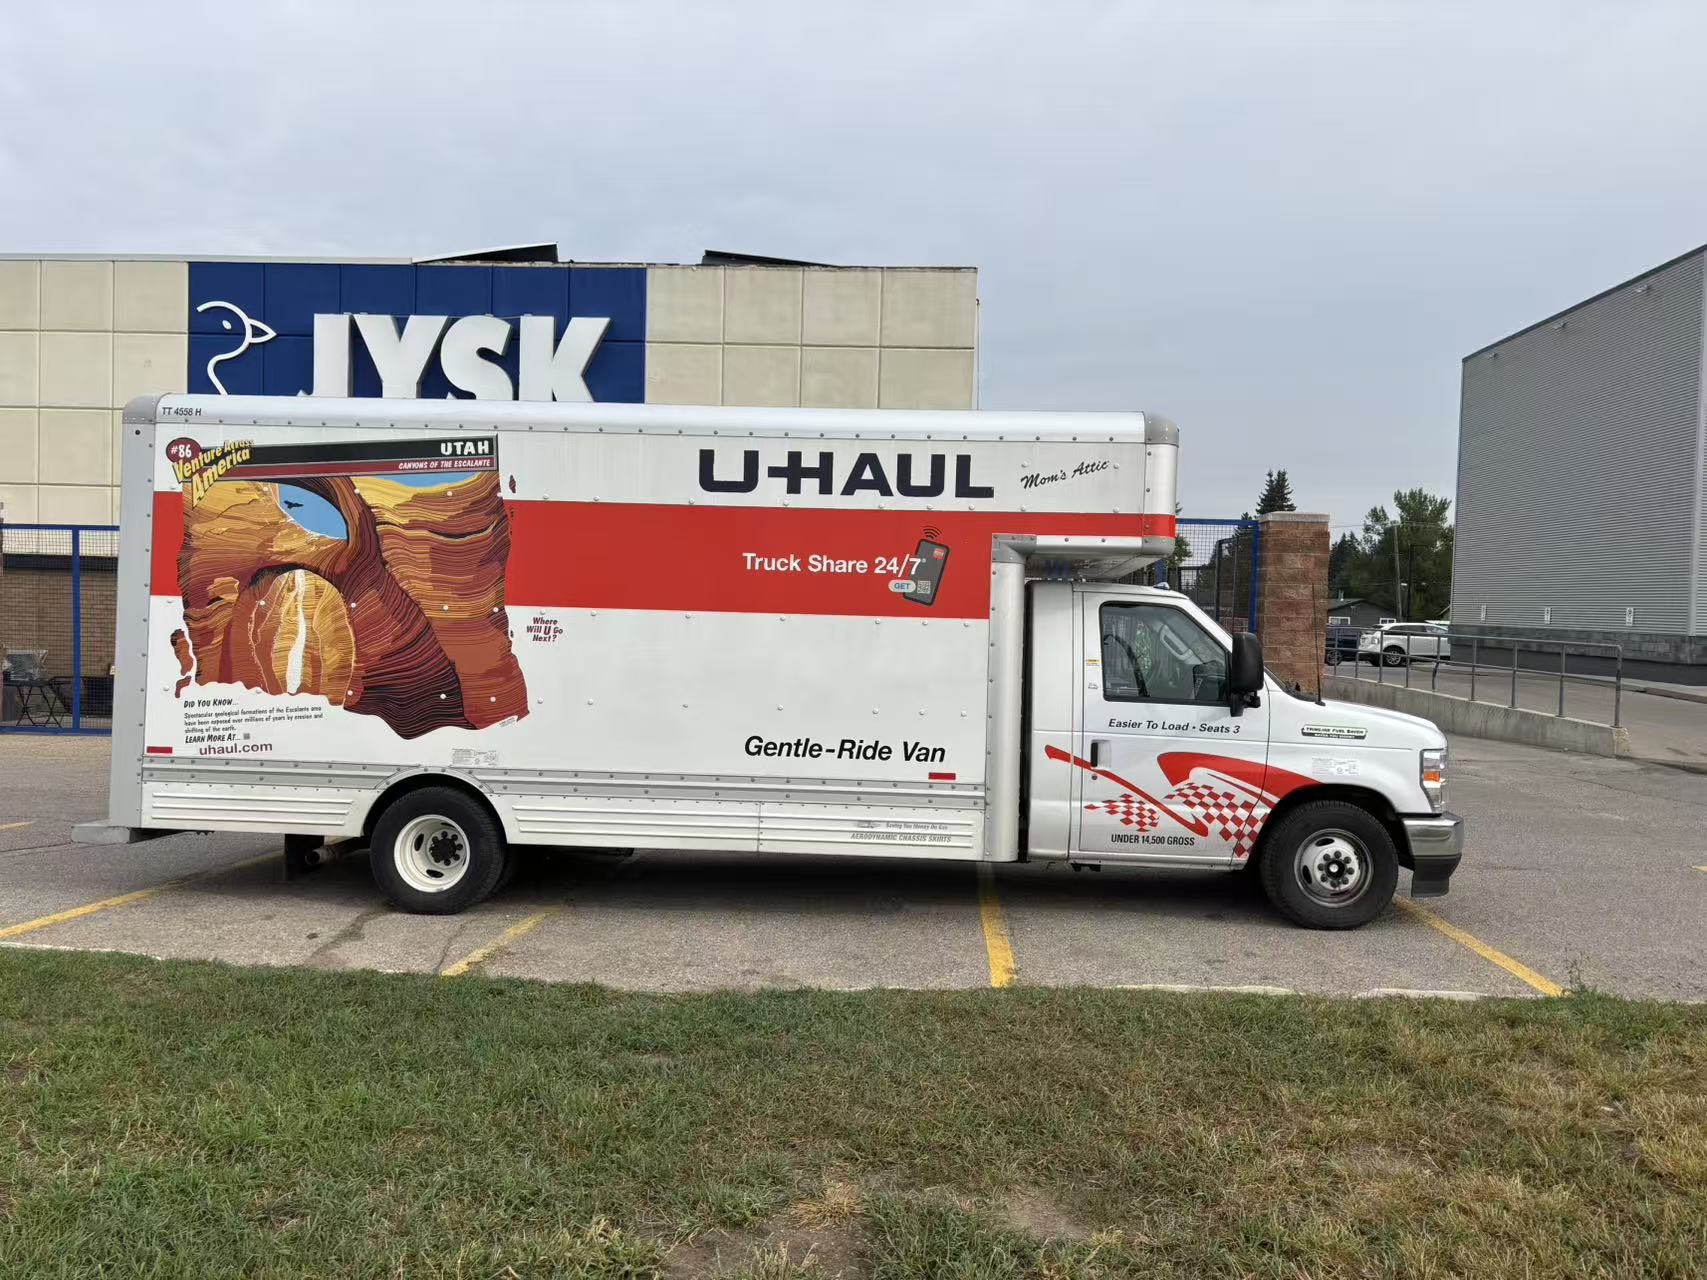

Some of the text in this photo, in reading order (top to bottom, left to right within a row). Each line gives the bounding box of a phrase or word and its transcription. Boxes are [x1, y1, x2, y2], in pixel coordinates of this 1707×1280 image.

[297, 313, 611, 402] JYSK
[162, 407, 173, 415] TT
[195, 407, 202, 416] H
[171, 444, 192, 458] #86
[440, 440, 489, 456] UTAH
[172, 446, 223, 484] Venture
[398, 458, 491, 470] CANYONS OF THE ESCALANTE
[192, 447, 251, 510] America
[699, 449, 994, 498] U-HAUL
[1020, 460, 1110, 490] Mom's Attic
[742, 552, 801, 572] Truck
[807, 554, 868, 574] Share
[894, 582, 910, 590] GET
[533, 616, 558, 625] Where
[526, 625, 563, 636] Will U Go
[214, 710, 239, 718] geological
[241, 708, 267, 716] formations
[211, 718, 231, 726] exposed
[1108, 718, 1241, 734] Easier To Load Seats 3
[199, 743, 273, 756] uhaul.com
[744, 735, 946, 763] Gentle-Ride Van
[850, 832, 952, 844] AERODYNAMIC CHASSIS SKIRTS
[1111, 833, 1195, 847] UNDER 14,500 GROSS
